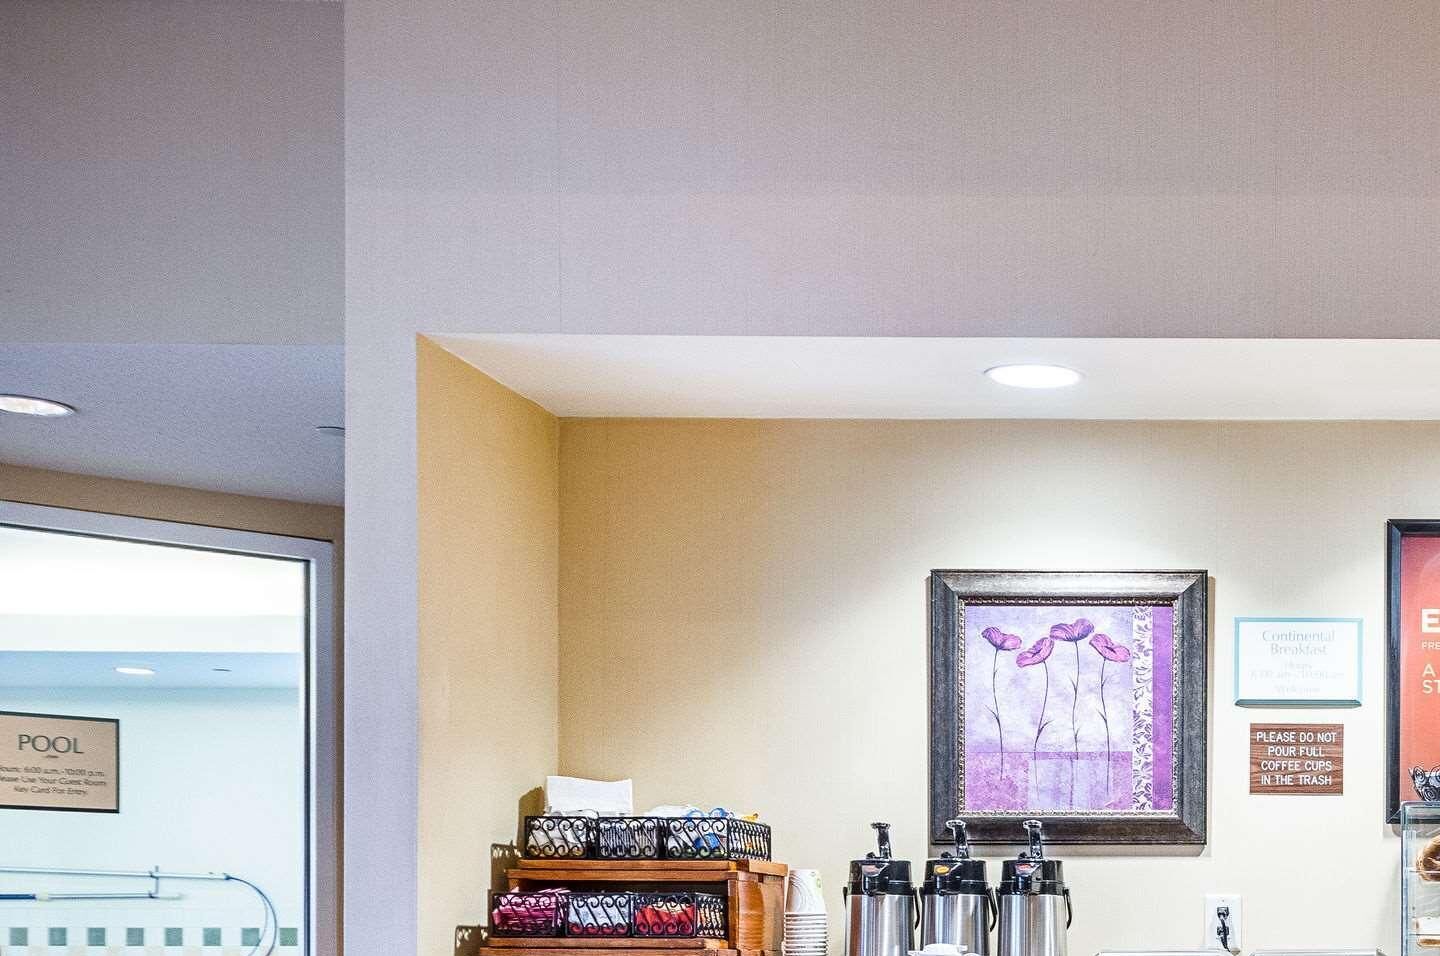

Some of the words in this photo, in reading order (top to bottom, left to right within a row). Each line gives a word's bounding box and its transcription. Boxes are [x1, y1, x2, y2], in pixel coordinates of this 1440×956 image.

[1262, 629, 1335, 642] Continental
[1270, 643, 1328, 656] Breakfast
[1422, 663, 1436, 677] A
[1256, 731, 1296, 743] PLEASE
[1299, 732, 1314, 743] DO
[1317, 732, 1337, 743] NOT
[18, 734, 85, 754] POOL
[1268, 746, 1296, 757] POUR
[1299, 746, 1325, 757] FULL
[1261, 760, 1300, 771] COFFEE
[1304, 760, 1333, 771] CUPS
[1261, 775, 1270, 786] IN
[1274, 775, 1294, 786] THE
[1299, 775, 1332, 786] TRASH
